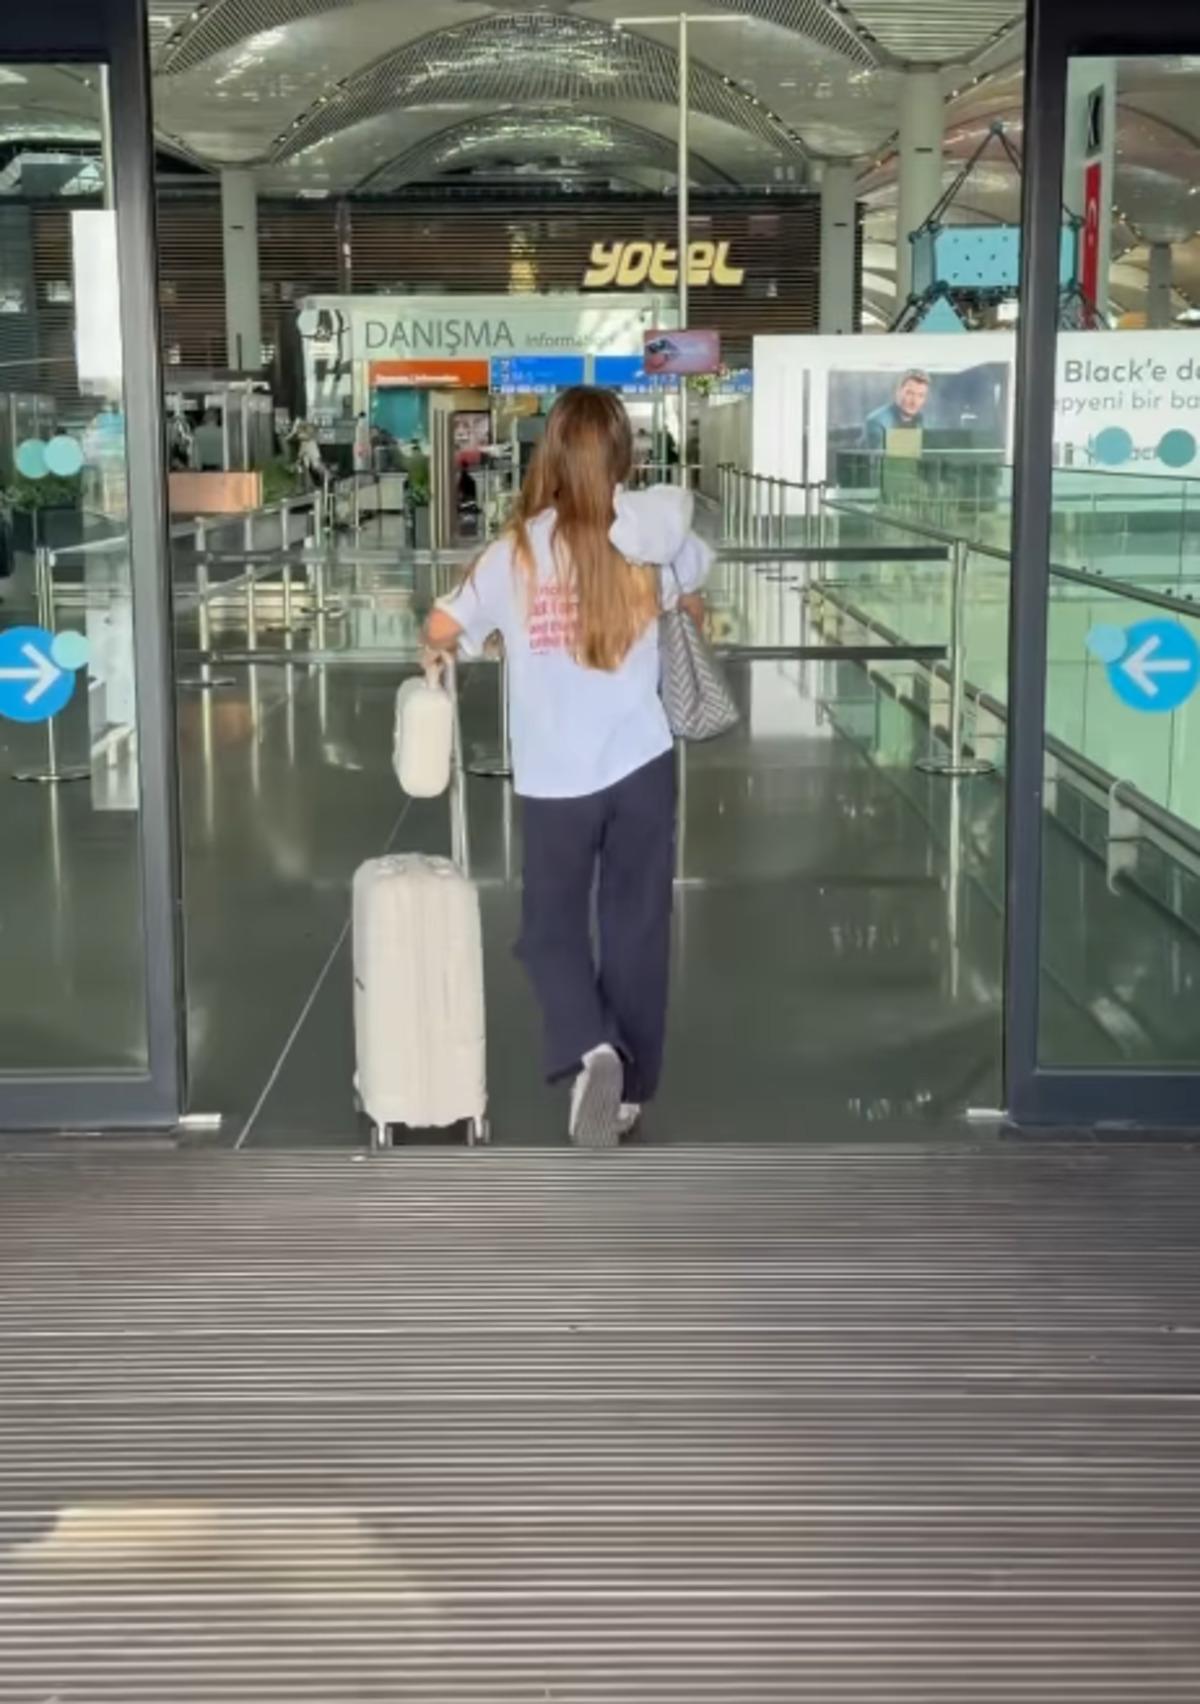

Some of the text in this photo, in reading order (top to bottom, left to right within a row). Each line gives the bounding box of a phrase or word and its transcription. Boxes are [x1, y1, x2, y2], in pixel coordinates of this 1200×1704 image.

[365, 320, 514, 355] DANIŞMA
[1064, 358, 1167, 382] Black'e
[1132, 390, 1161, 409] bir
